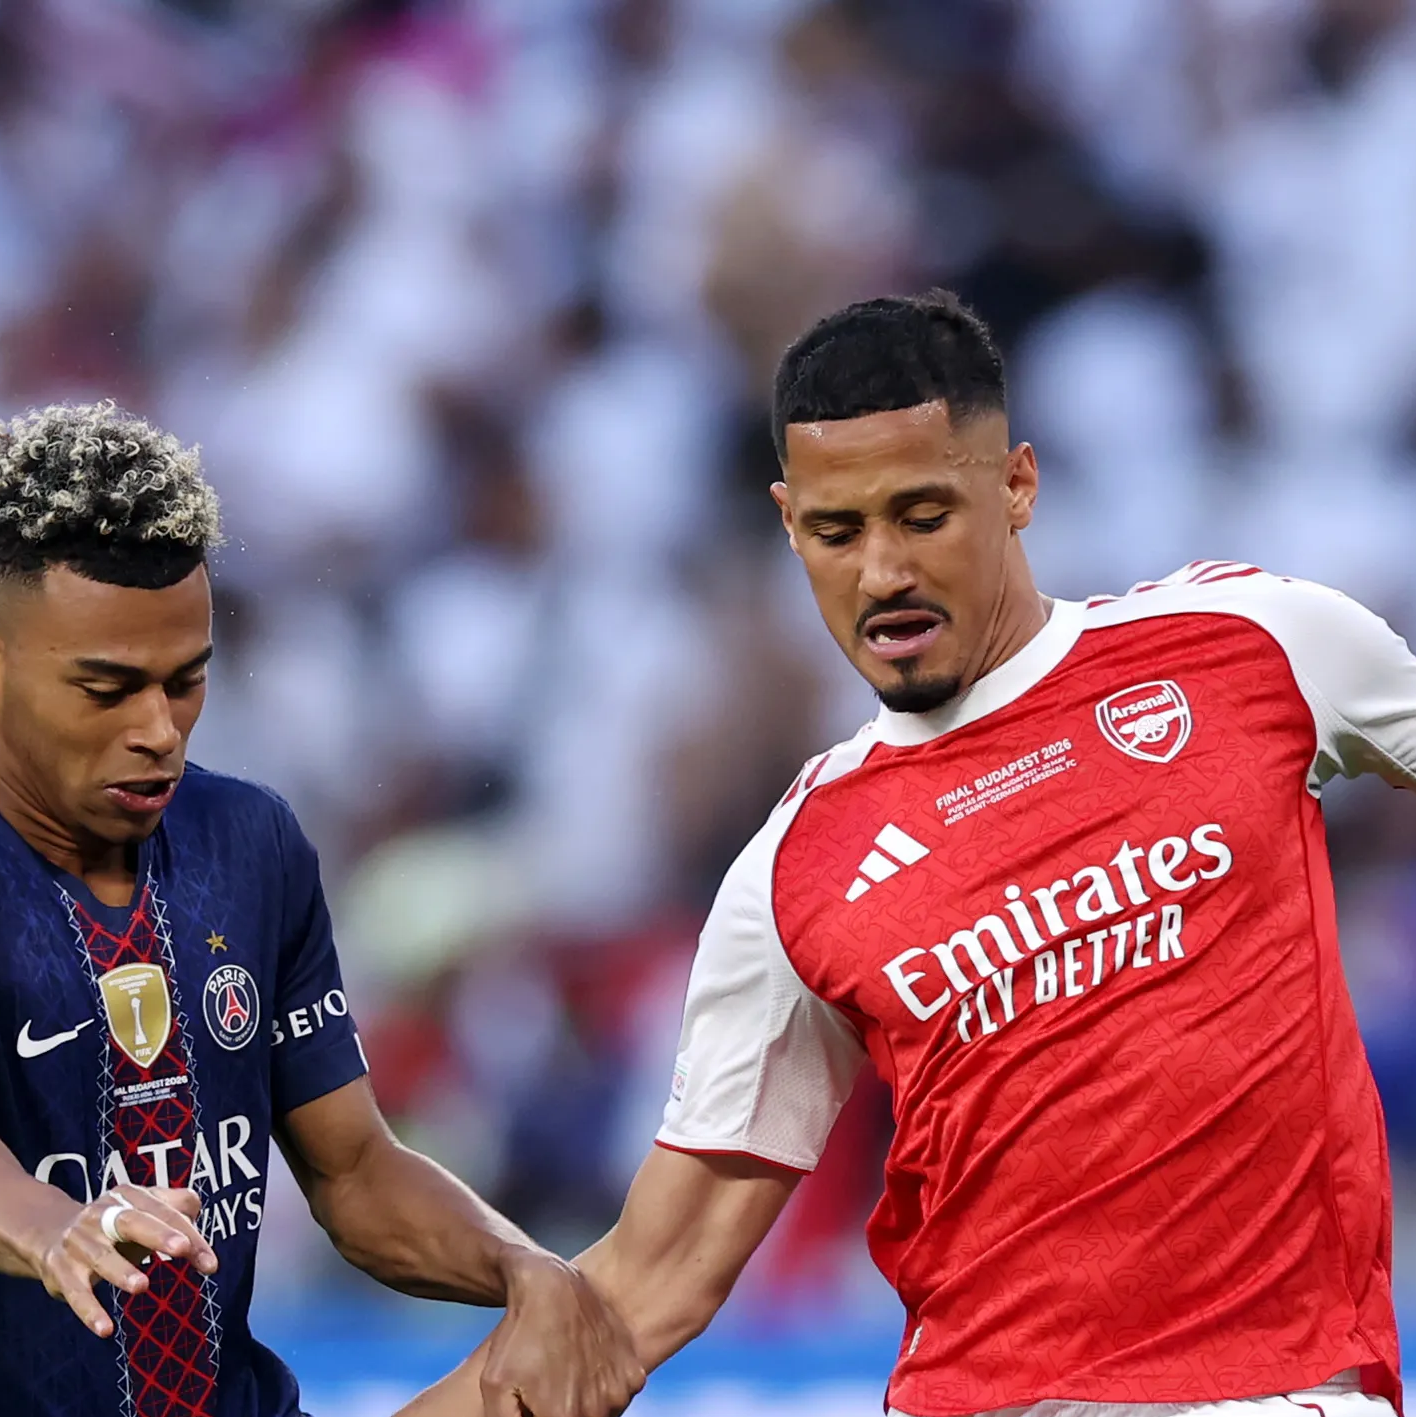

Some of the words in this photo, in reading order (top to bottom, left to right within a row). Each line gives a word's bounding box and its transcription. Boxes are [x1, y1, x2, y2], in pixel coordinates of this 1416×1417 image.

[1110, 689, 1172, 721] Arsenal
[935, 785, 973, 811] FINAL
[974, 752, 1040, 791] BUDAPEST
[1041, 738, 1072, 760] 2026
[944, 812, 965, 827] PARIS
[1031, 765, 1066, 784] ARSENAL
[1065, 759, 1078, 769] FC
[947, 796, 976, 816] PUSKÁS
[1001, 769, 1037, 791] BUDAPEST
[881, 823, 1233, 1022] Emirates
[209, 969, 247, 994] PARIS
[957, 967, 1016, 1043] FLY
[1033, 903, 1185, 1006] BETTER
[128, 1079, 164, 1094] BUDAPEST
[164, 1075, 189, 1087] 2026
[35, 1114, 261, 1205] QATAR
